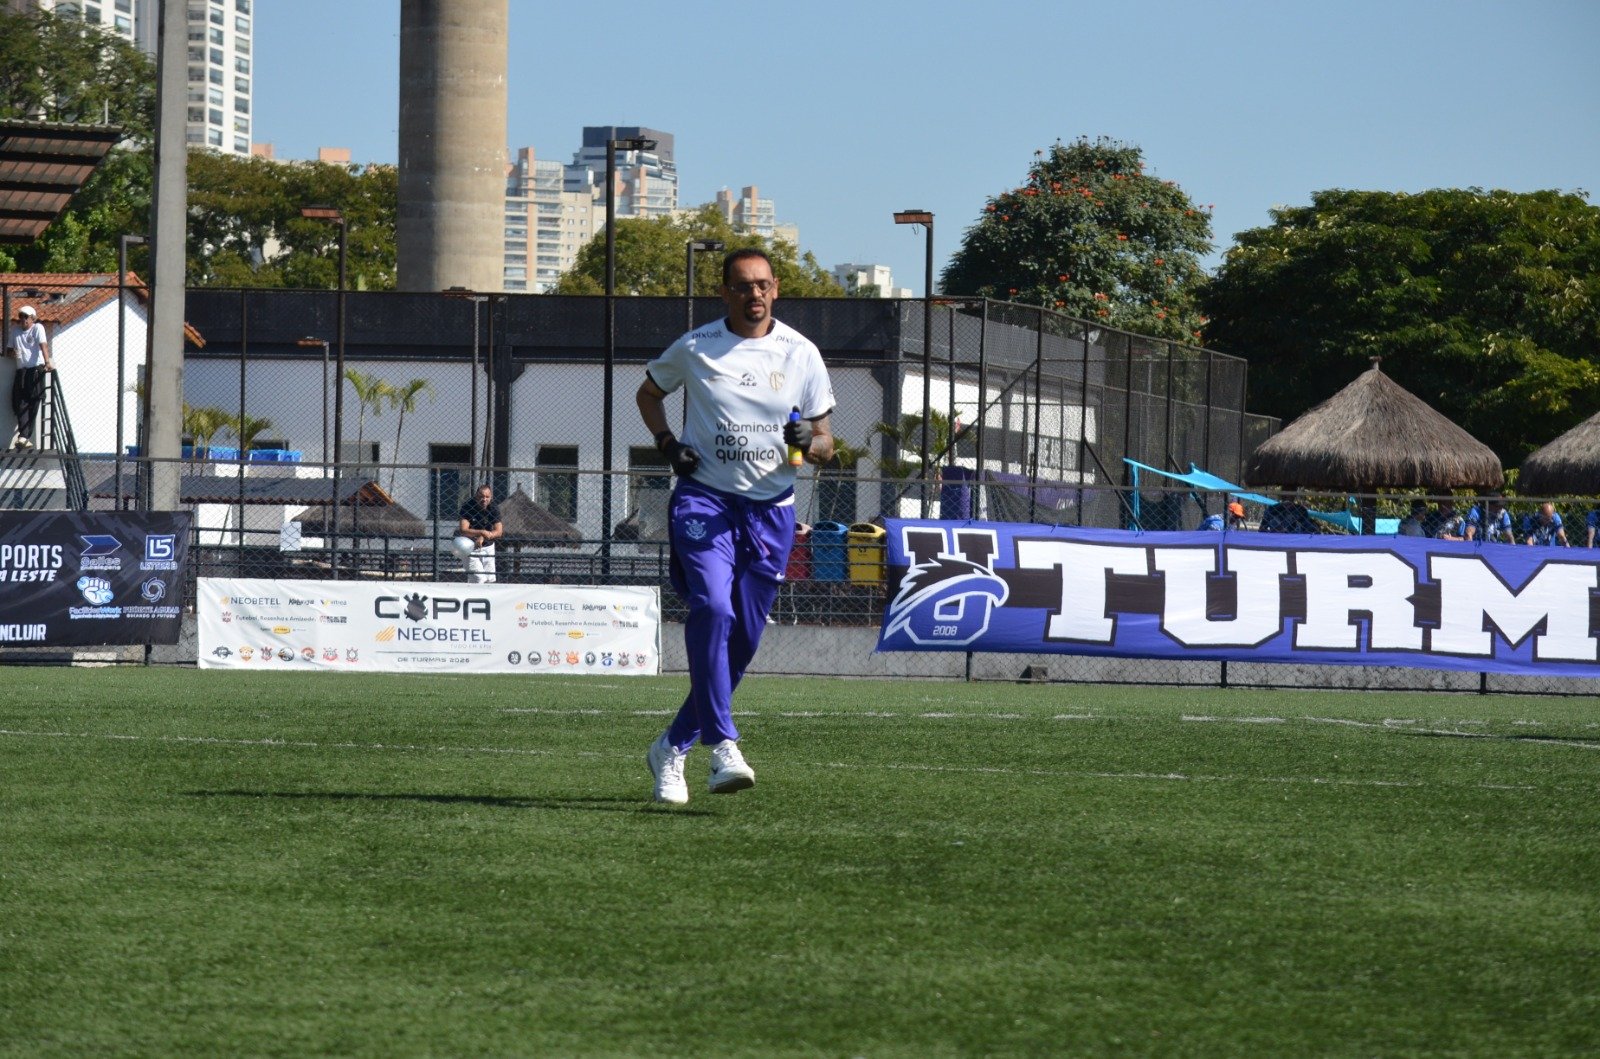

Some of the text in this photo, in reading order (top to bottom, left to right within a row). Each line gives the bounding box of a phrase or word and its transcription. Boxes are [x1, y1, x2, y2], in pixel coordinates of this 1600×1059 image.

[691, 330, 722, 340] pixbet
[715, 422, 779, 433] vitaminas
[715, 434, 749, 447] neo
[715, 448, 775, 464] química
[1, 544, 63, 569] PORTS
[10, 569, 58, 582] LESTE
[231, 597, 280, 605] NEOBETEL
[1017, 540, 1598, 661] TURM
[0, 623, 47, 641] NCLUIR
[398, 628, 491, 641] NEOBETEL
[932, 625, 958, 636] 2008
